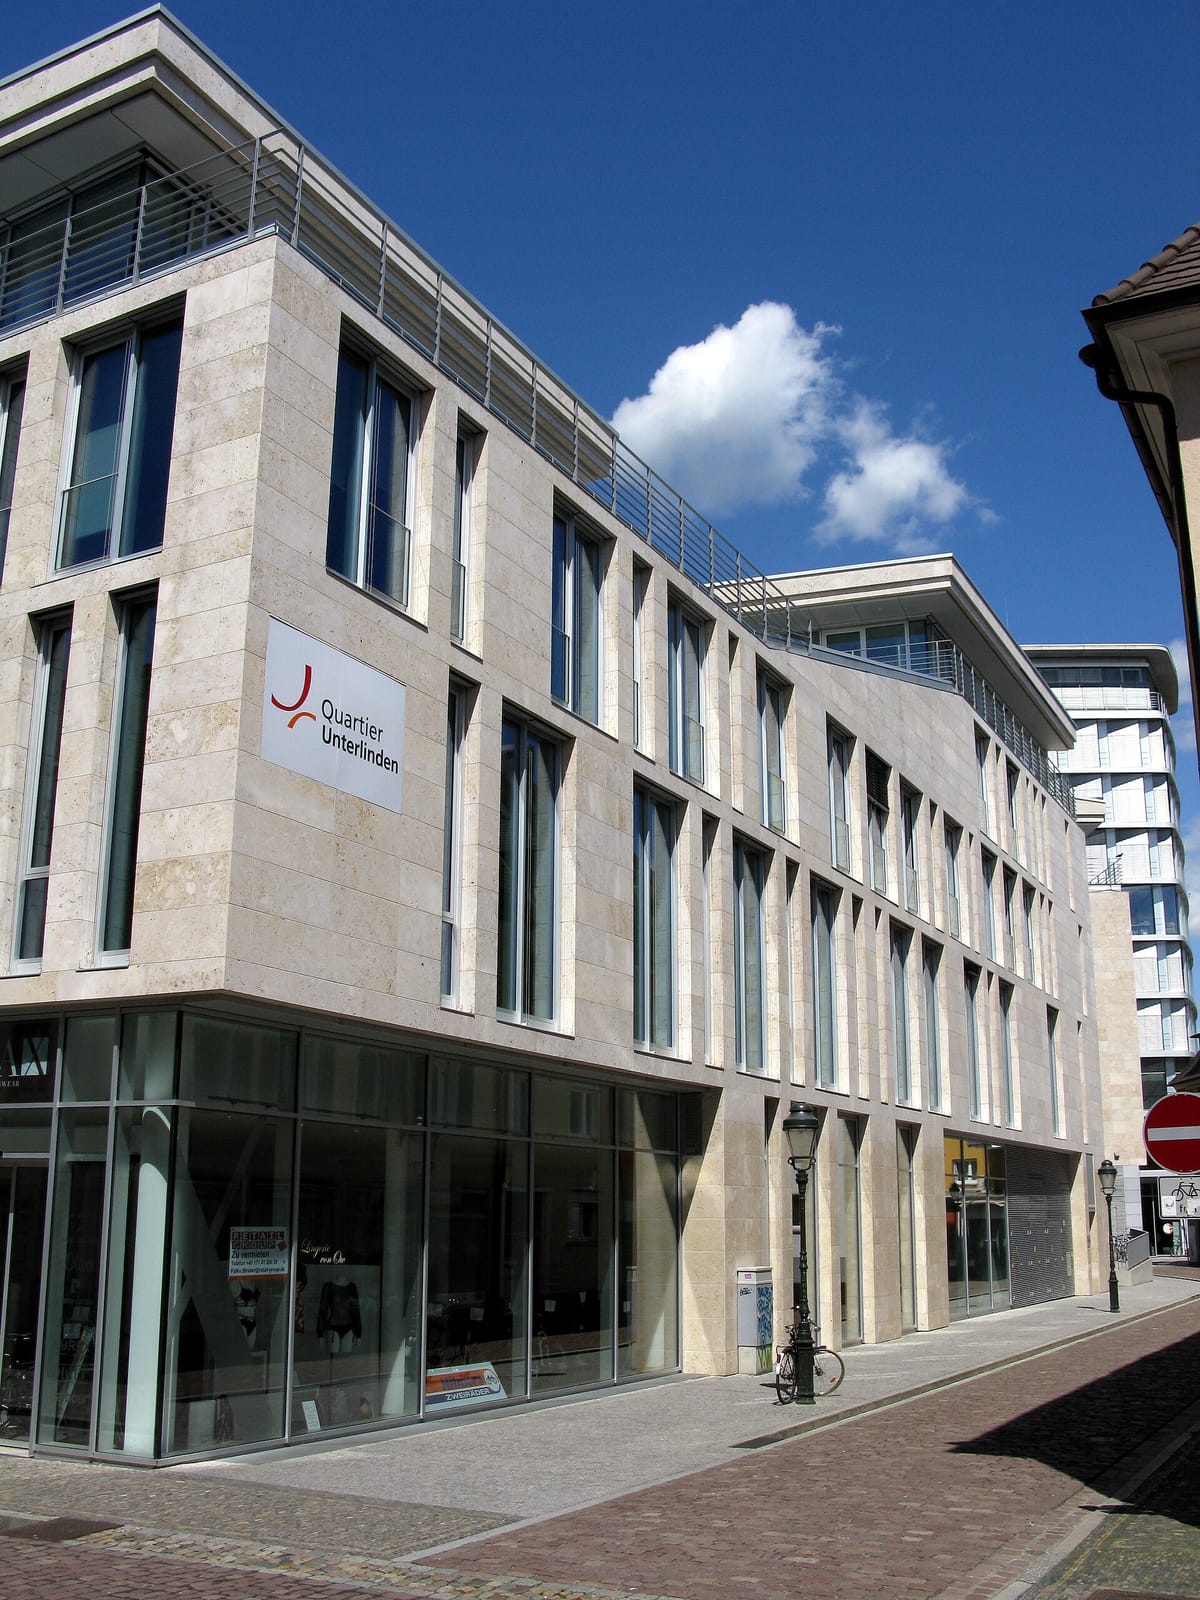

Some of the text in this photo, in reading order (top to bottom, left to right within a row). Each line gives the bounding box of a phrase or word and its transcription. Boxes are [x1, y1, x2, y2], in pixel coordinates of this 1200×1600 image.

[321, 699, 383, 742] Quartier
[322, 725, 399, 774] Unterlinden
[232, 1231, 283, 1240] RETAIL
[232, 1240, 276, 1249] GROUP
[231, 1250, 240, 1258] Zu
[446, 1388, 490, 1400] ZWEIRÄDER
